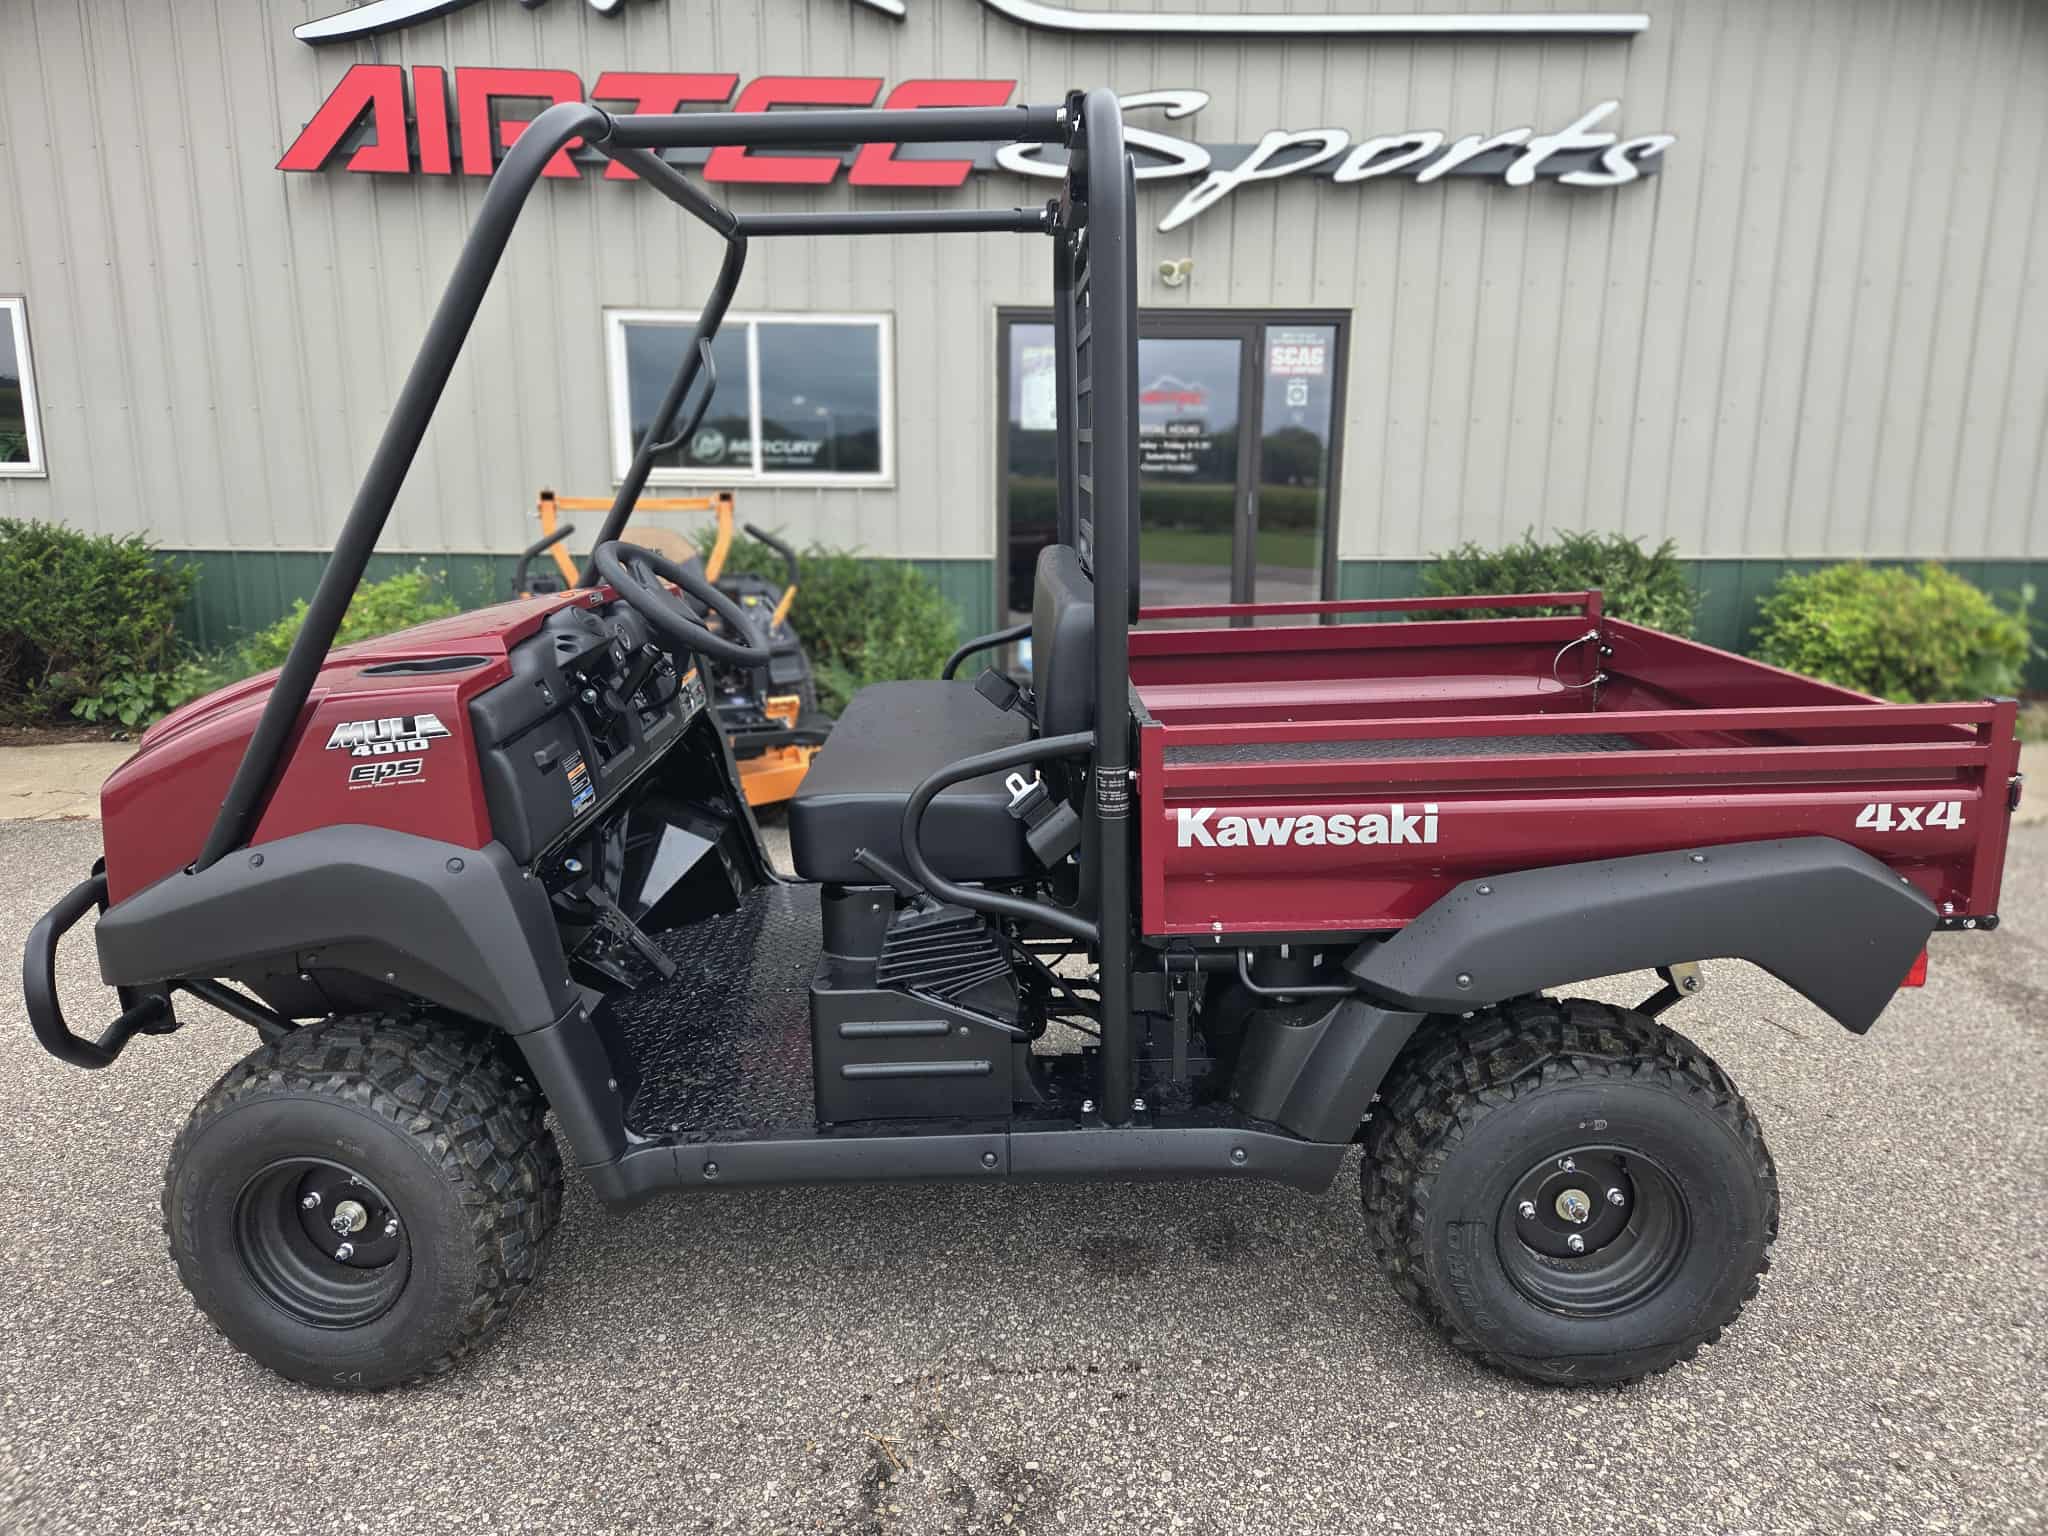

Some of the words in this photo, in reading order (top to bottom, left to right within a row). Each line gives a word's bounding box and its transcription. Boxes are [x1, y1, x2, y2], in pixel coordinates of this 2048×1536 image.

[275, 64, 1017, 186] AIRTEC
[996, 89, 1675, 232] Sports
[351, 739, 429, 756] 4010
[1177, 804, 1438, 847] Kawasaki
[1856, 801, 1966, 831] 4x4
